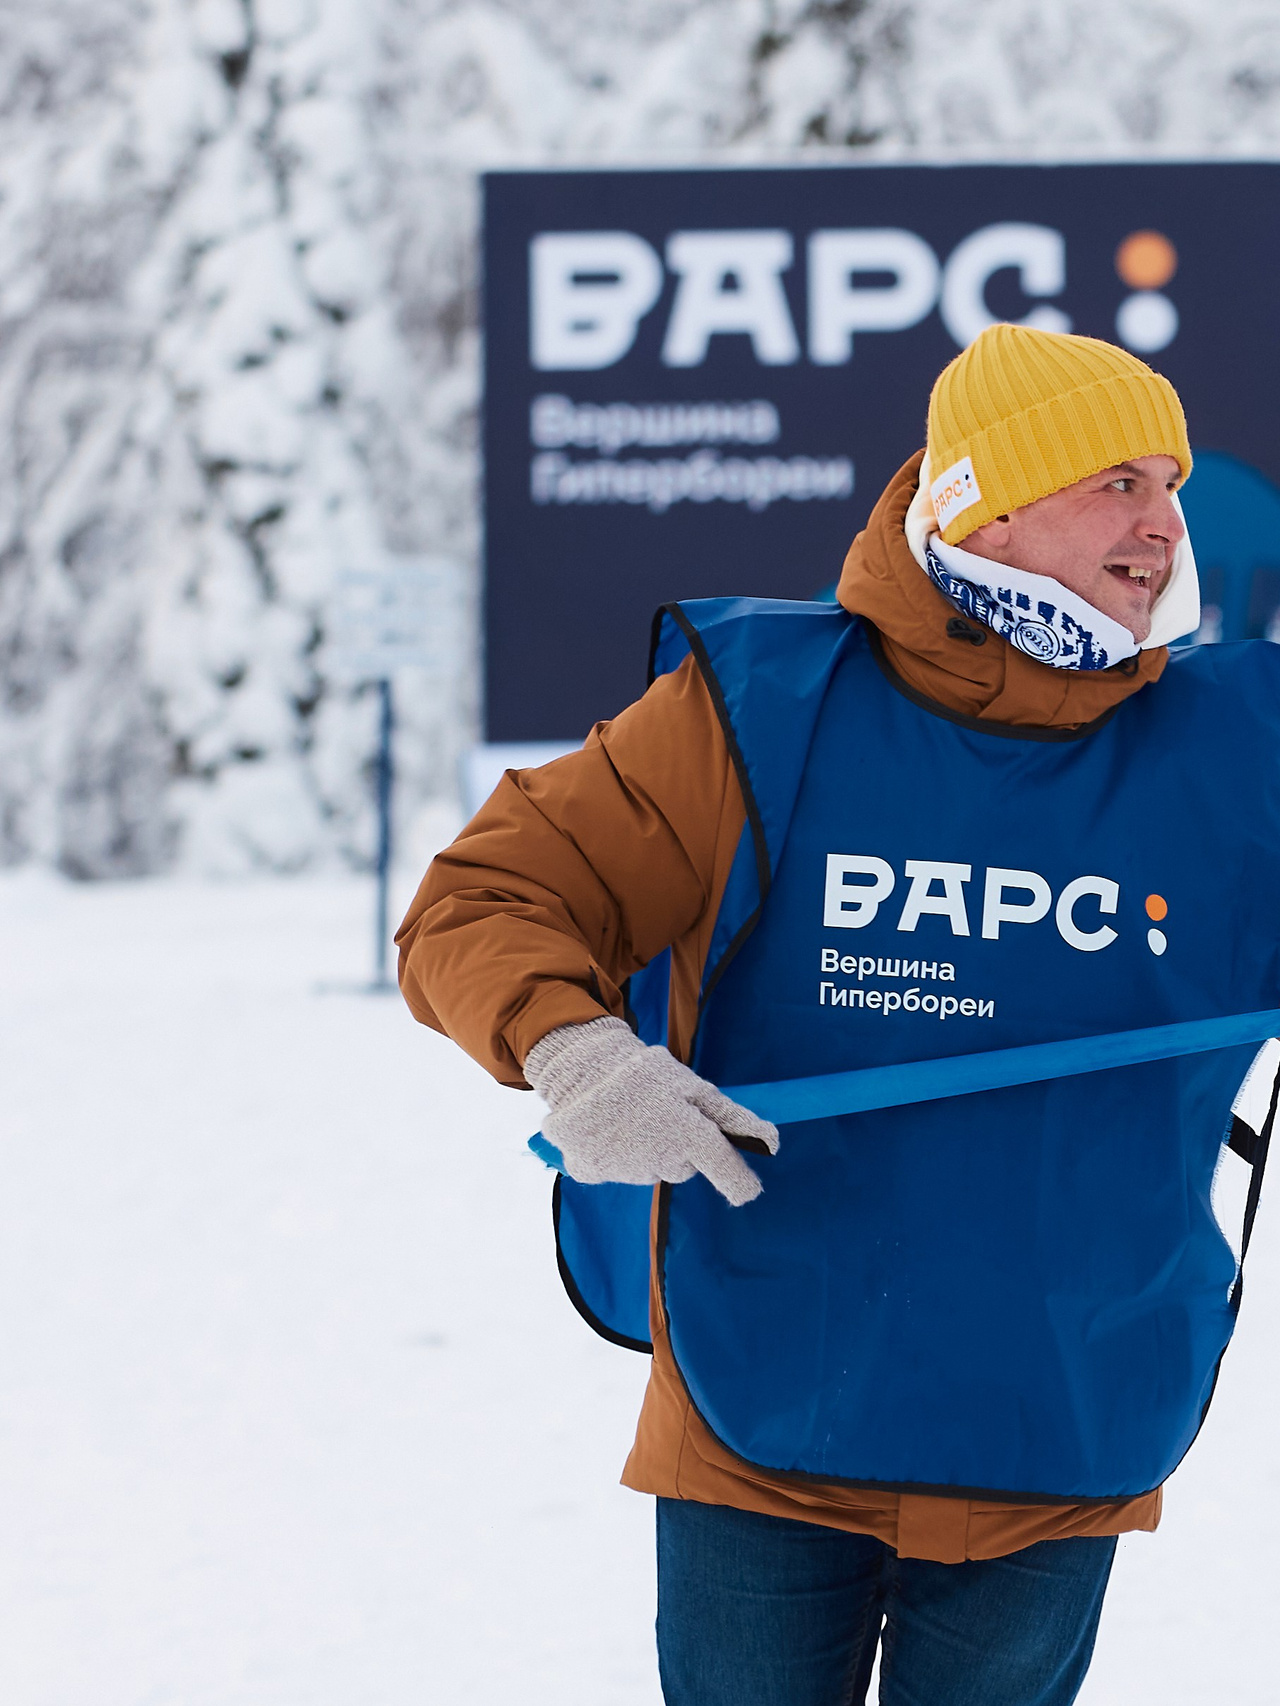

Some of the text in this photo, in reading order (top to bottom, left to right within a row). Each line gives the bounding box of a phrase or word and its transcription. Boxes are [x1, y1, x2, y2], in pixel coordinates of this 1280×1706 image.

[531, 396, 779, 456] Вершина
[531, 449, 854, 513] Гипербореи
[820, 948, 955, 982] Вершина
[819, 981, 995, 1020] Гипербореи
